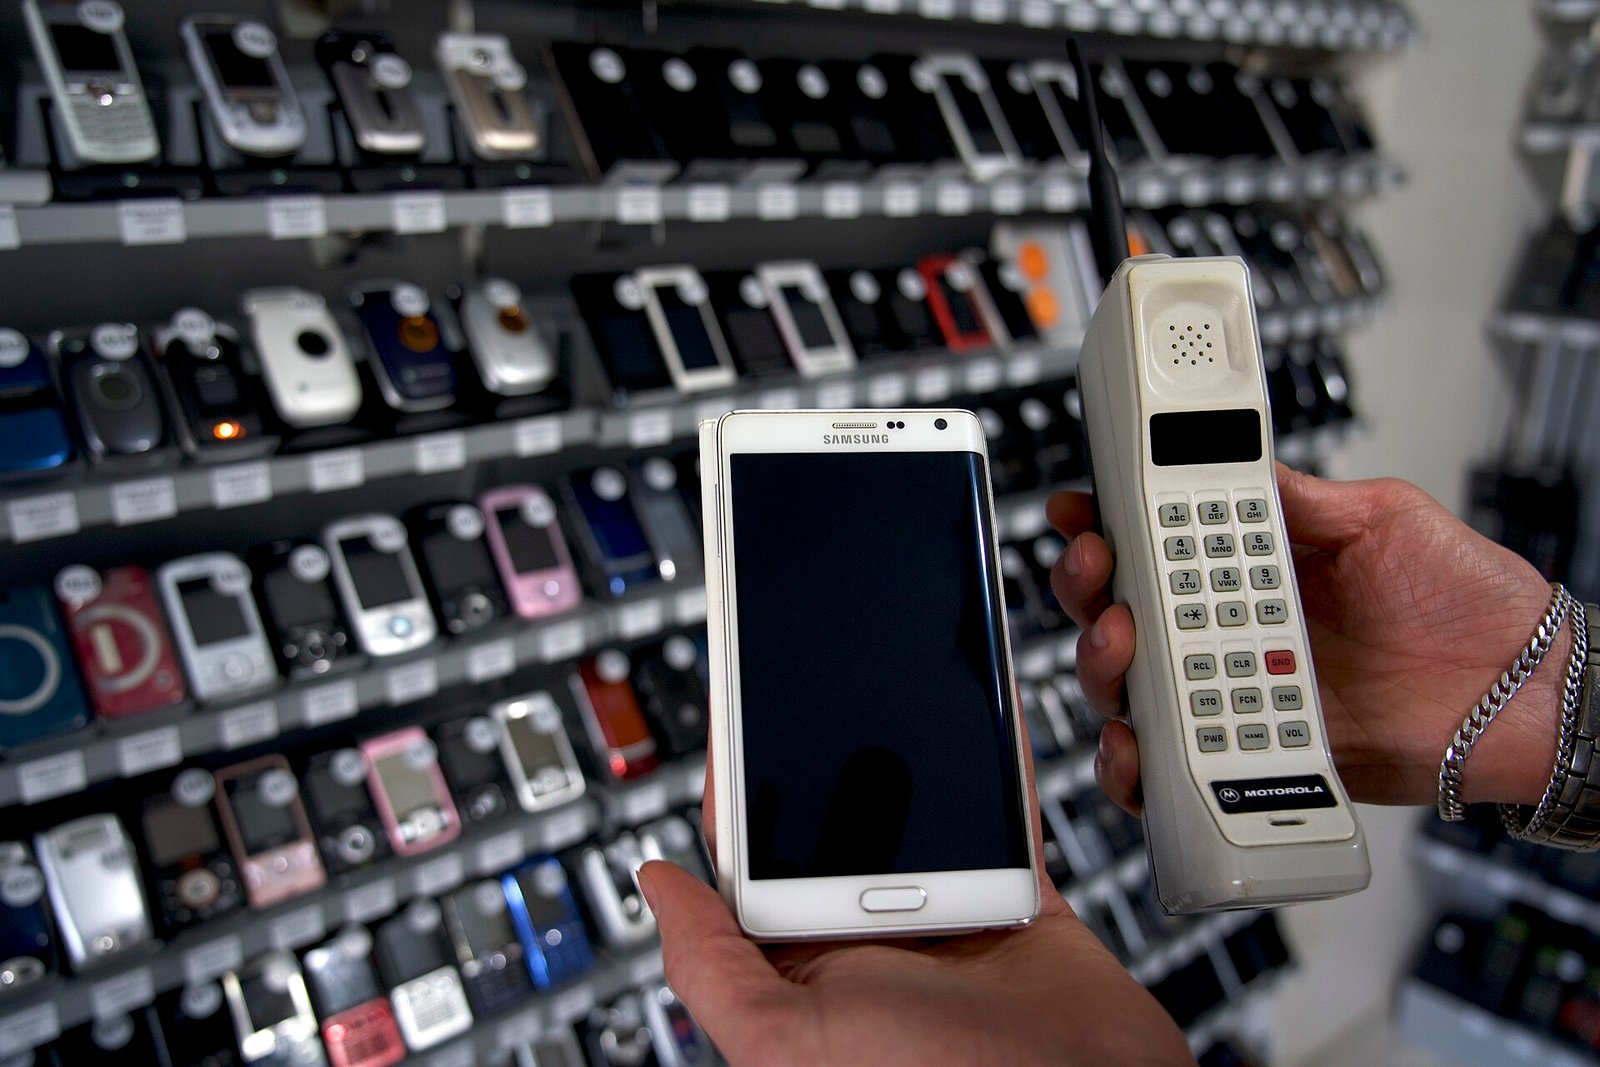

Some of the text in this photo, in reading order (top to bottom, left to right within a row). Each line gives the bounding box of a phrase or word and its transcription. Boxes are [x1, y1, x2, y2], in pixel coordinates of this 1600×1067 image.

[823, 434, 889, 444] SAMSUNG
[1172, 506, 1178, 514] 1
[1211, 504, 1218, 512] 2
[1249, 502, 1257, 511] 3
[1216, 537, 1224, 545] 5
[1256, 535, 1263, 543] 6
[1177, 539, 1184, 548] 4
[1182, 573, 1190, 581] 7
[1223, 571, 1230, 579] 8
[1262, 569, 1269, 577] 9
[1234, 660, 1250, 668] CLR
[1200, 698, 1216, 706] STO
[1240, 696, 1256, 704] FCN
[1278, 694, 1297, 702] END
[1244, 786, 1324, 797] MOTOROLA
